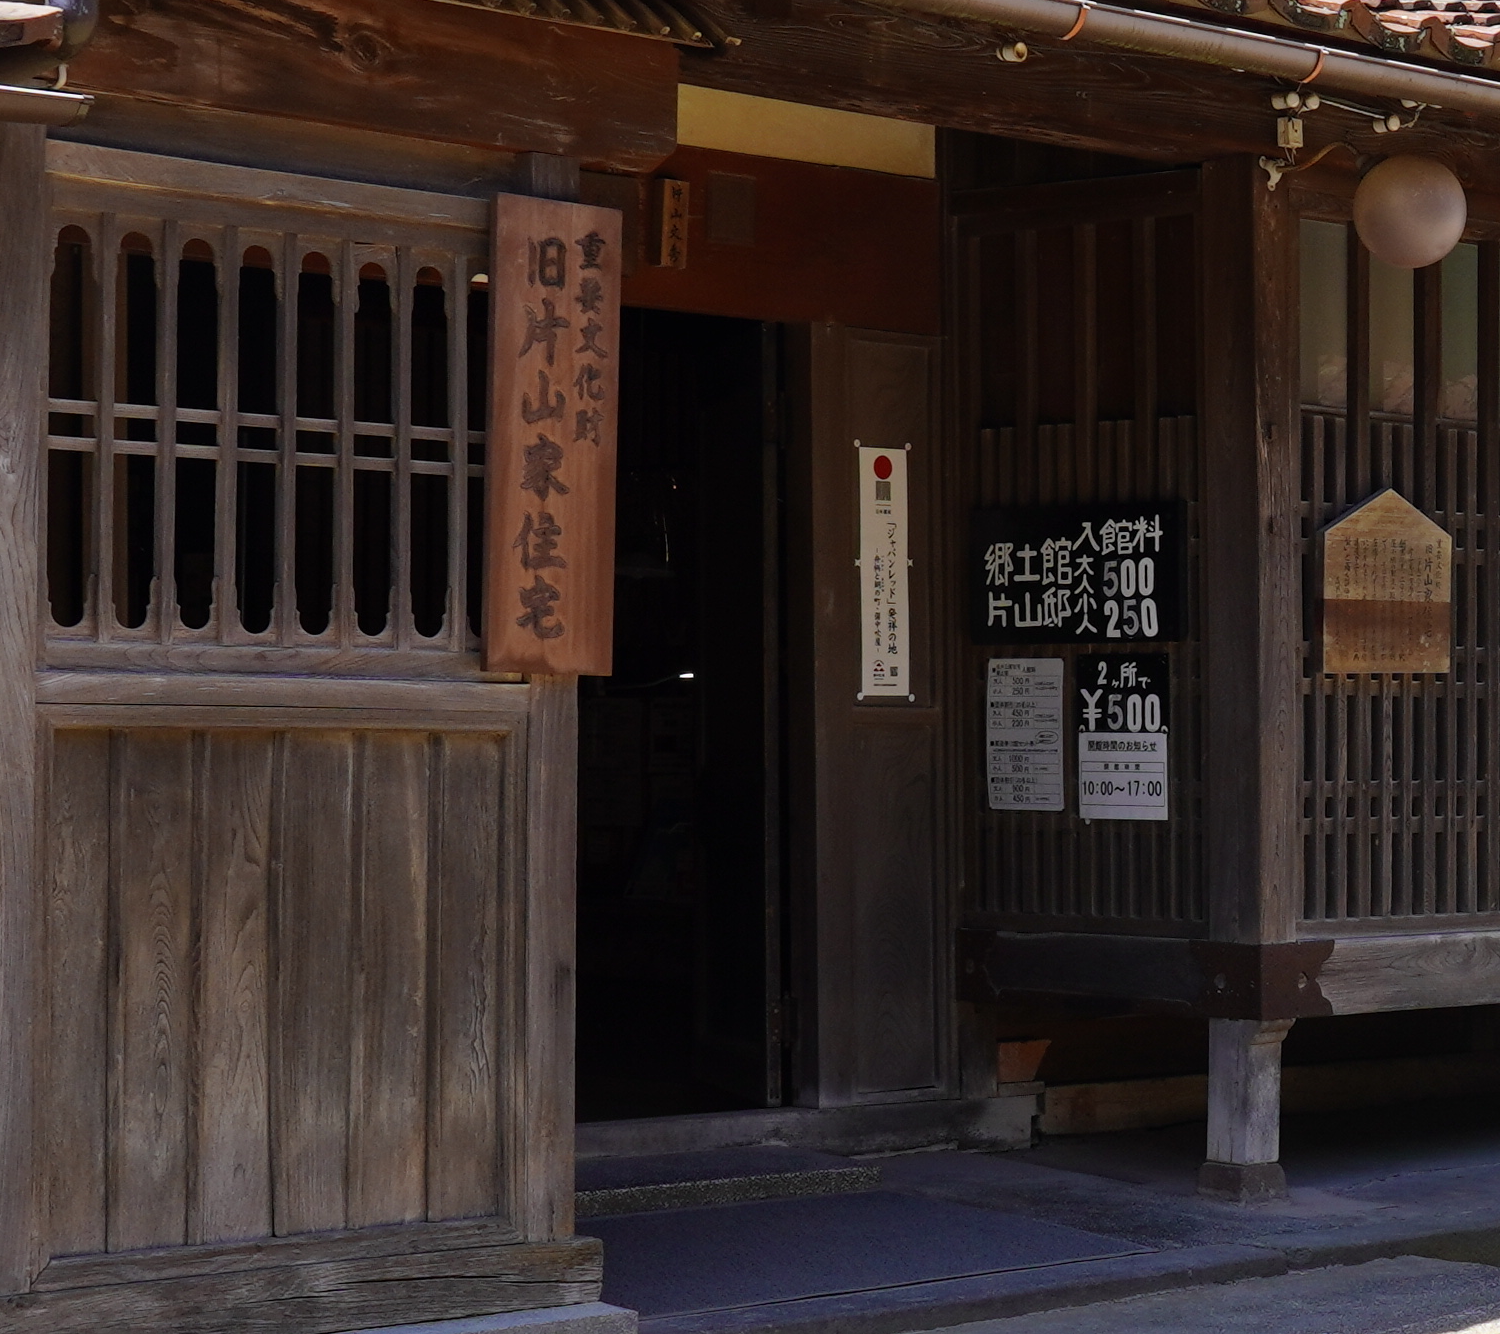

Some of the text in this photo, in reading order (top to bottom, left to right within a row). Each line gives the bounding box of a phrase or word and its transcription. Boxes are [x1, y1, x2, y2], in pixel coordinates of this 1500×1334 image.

[573, 231, 609, 449] 重要文化財
[514, 234, 571, 641] 旧片山家住宅
[1072, 514, 1164, 556] 入館料
[984, 536, 1155, 598] 郷土館 大人 500
[987, 586, 1159, 638] 片山邸 小人 250
[1080, 688, 1161, 733] ¥500
